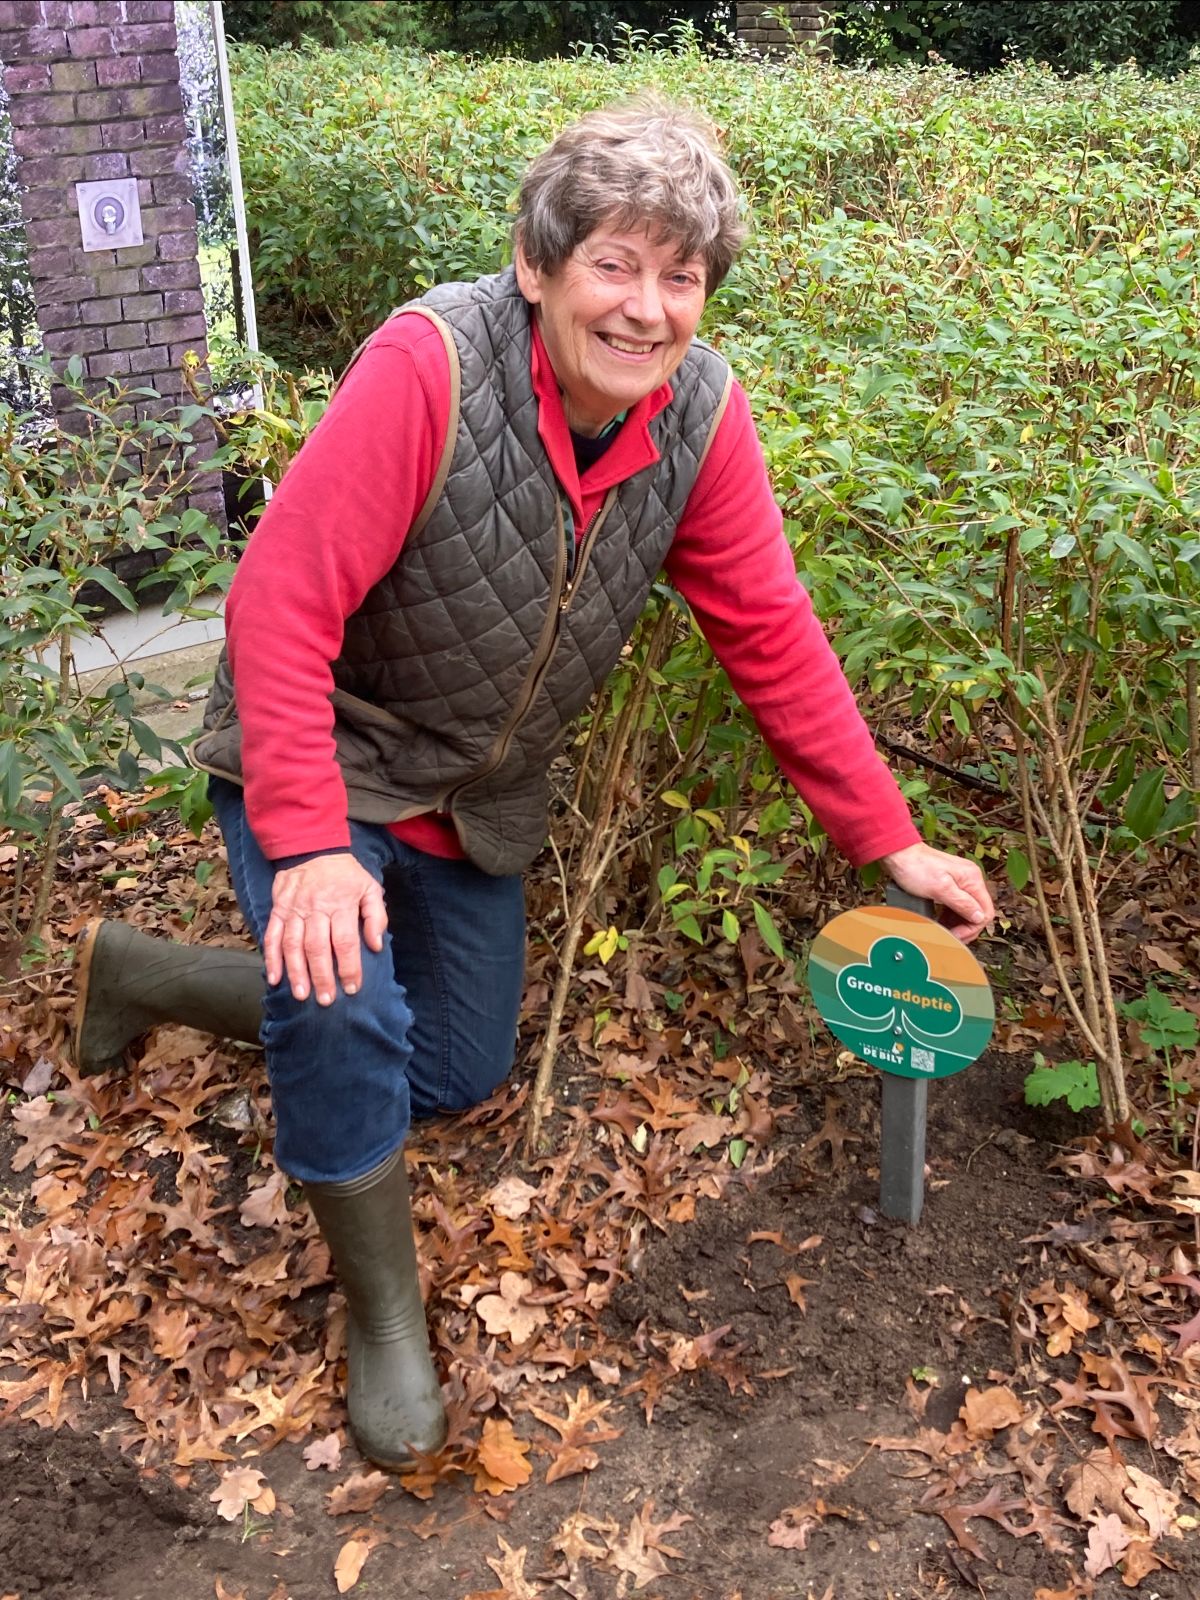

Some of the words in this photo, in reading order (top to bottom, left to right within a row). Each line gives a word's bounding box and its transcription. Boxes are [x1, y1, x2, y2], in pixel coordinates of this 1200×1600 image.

[846, 976, 952, 1012] Groenadoptie
[863, 1047, 877, 1058] DE
[880, 1051, 903, 1064] BILT
